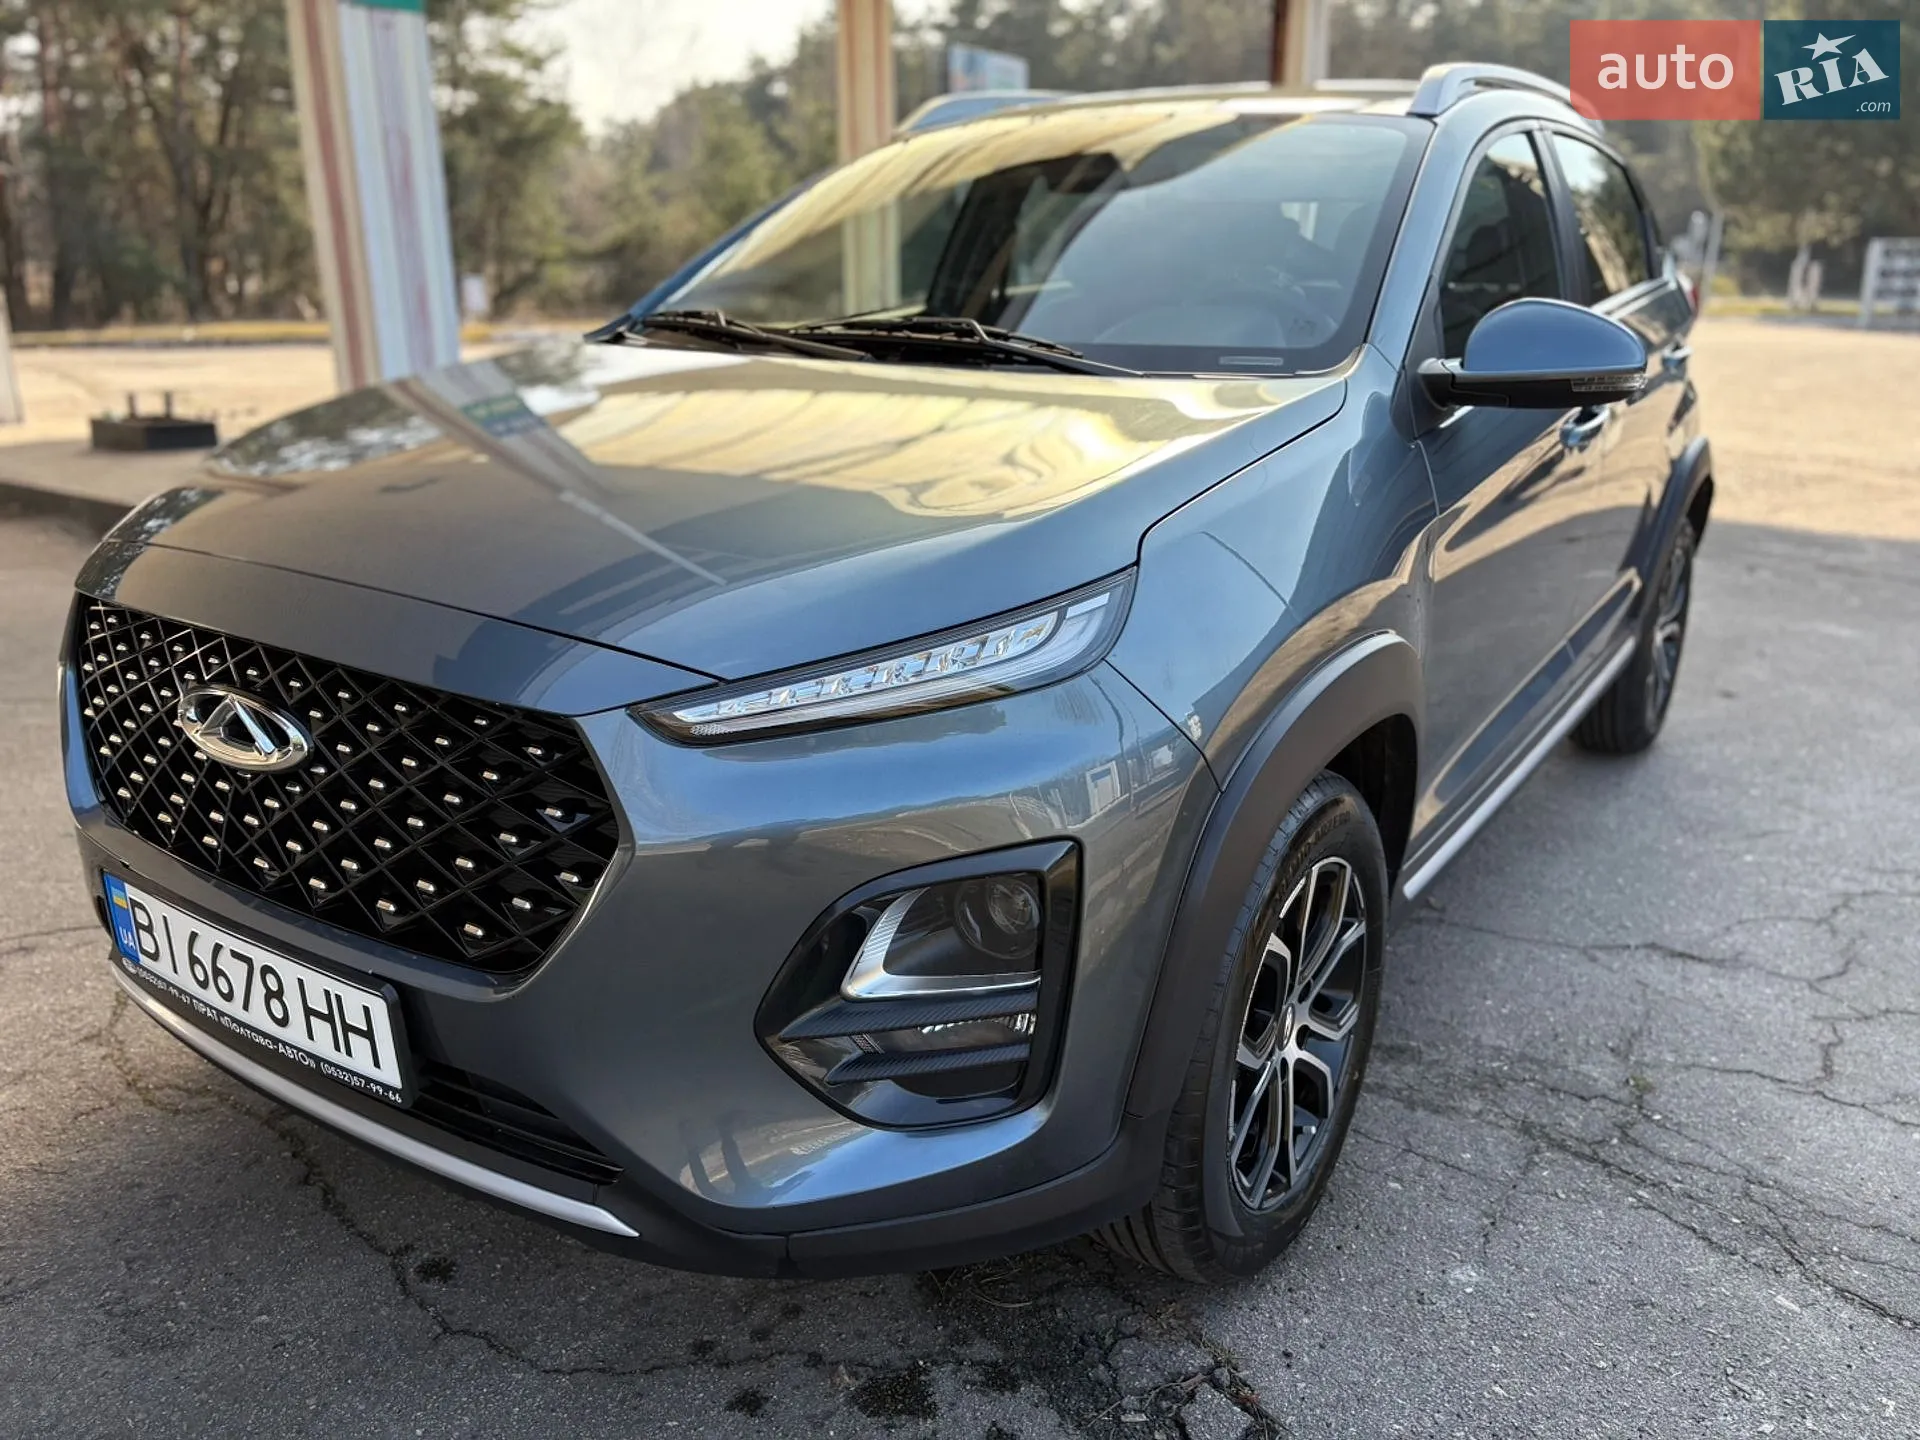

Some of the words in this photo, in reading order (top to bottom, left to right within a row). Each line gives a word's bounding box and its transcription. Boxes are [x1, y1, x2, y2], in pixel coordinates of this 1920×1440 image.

[119, 926, 136, 950] UA
[128, 897, 179, 976] BI
[188, 929, 290, 1028] 6678
[298, 976, 382, 1070] HH
